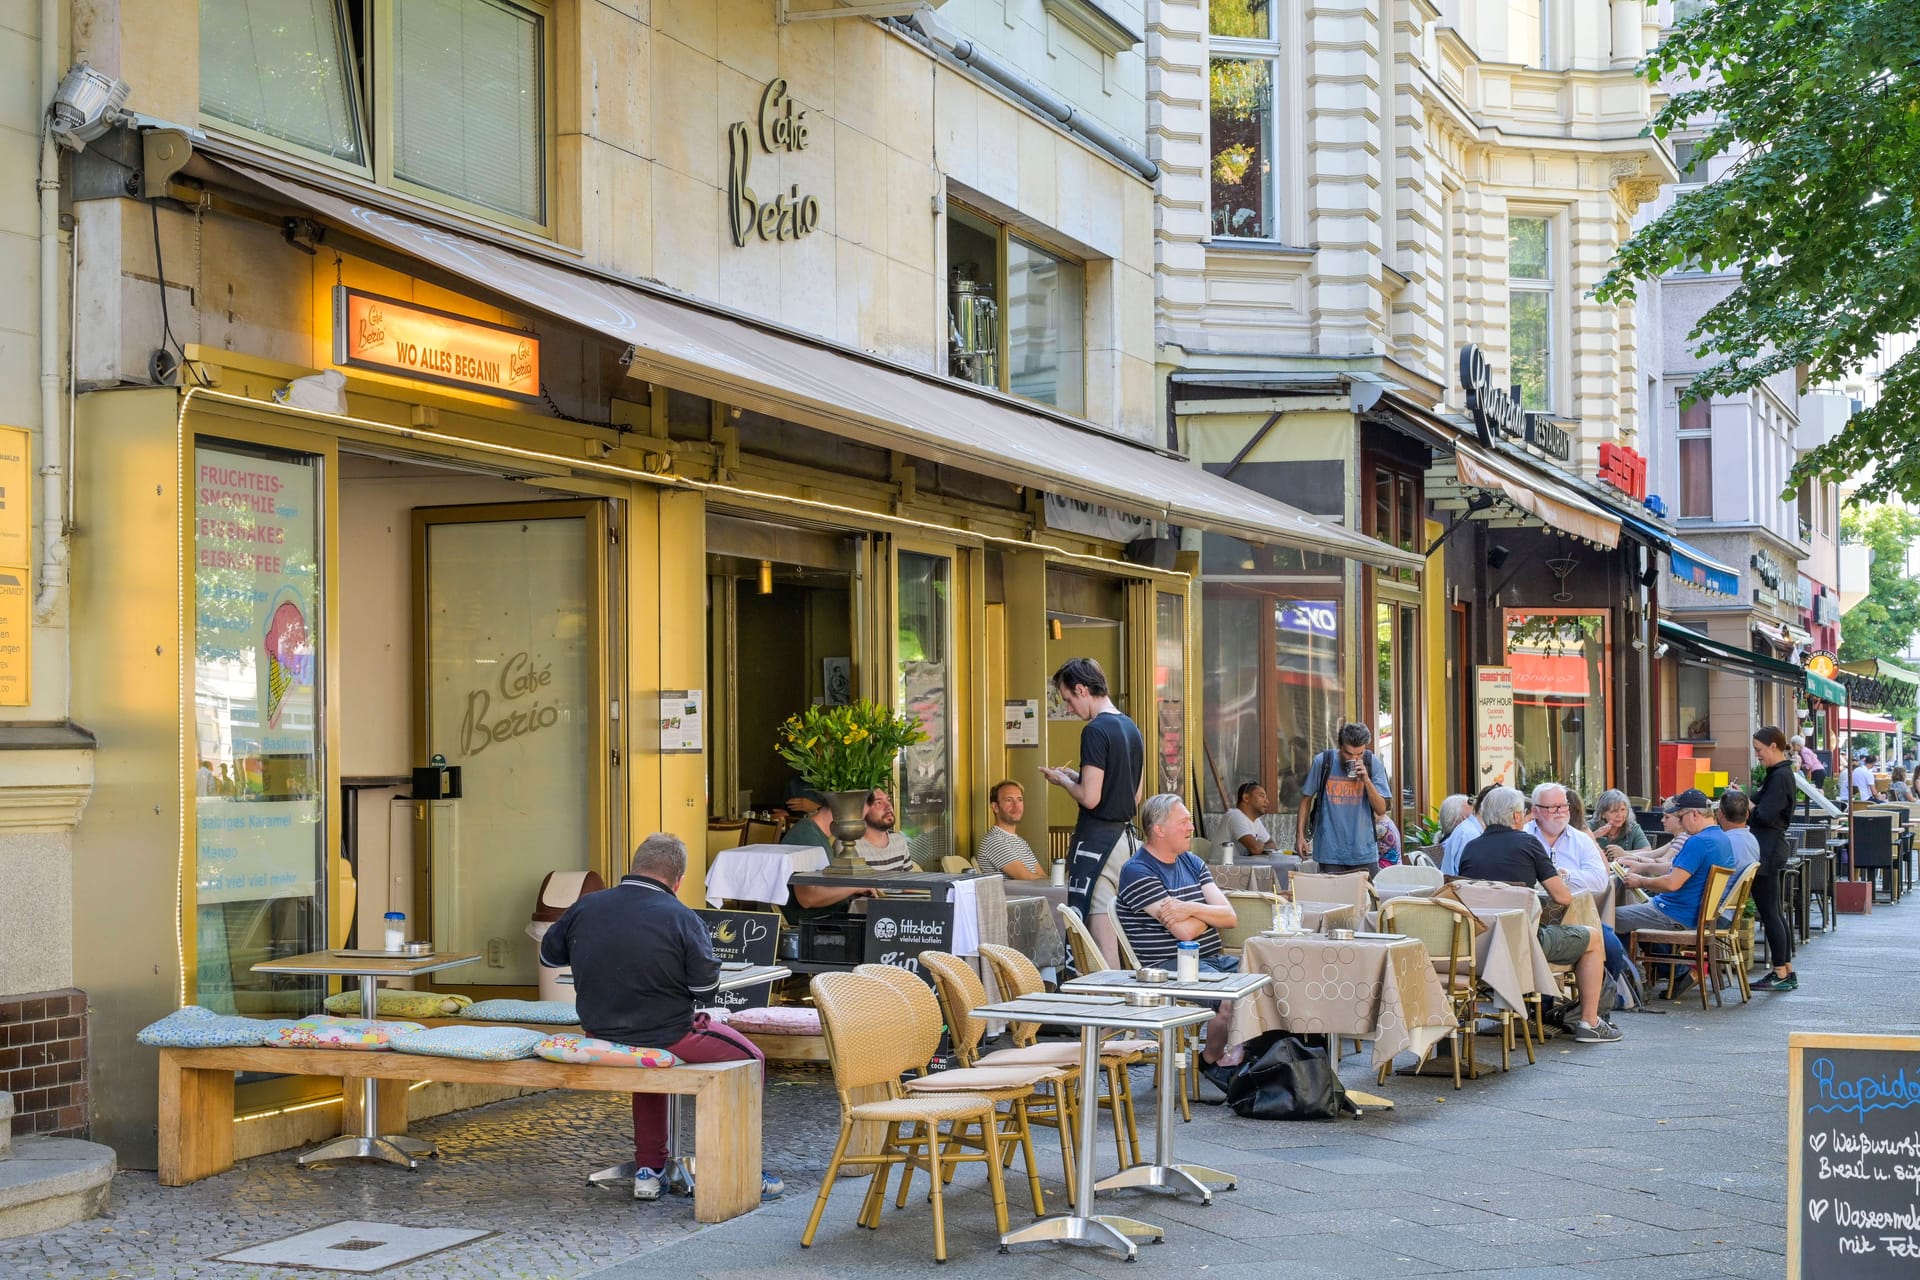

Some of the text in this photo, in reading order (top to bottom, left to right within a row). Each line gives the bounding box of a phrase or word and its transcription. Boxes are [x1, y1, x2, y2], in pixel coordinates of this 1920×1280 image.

[758, 77, 809, 154] Café
[728, 121, 821, 248] Berio
[368, 304, 383, 327] Café
[358, 318, 385, 348] Berio
[396, 341, 417, 366] WO
[420, 347, 452, 373] ALLES
[455, 354, 500, 383] BEGANN
[517, 340, 530, 361] Café
[509, 353, 532, 381] Berio
[1533, 414, 1570, 460] RESTAURANT
[200, 465, 285, 493] FRUCHTEIS-
[200, 488, 275, 514] SMOOTHIE
[500, 652, 552, 700] Café
[1480, 697, 1512, 706] HAPPY HOUR
[460, 689, 558, 757] Berio
[1488, 724, 1512, 740] 4,90€
[201, 846, 238, 862] Mango
[203, 872, 296, 891] und viel viel mehr
[900, 935, 942, 944] vielviel koffein
[1839, 1235, 1920, 1258] mit Fet
